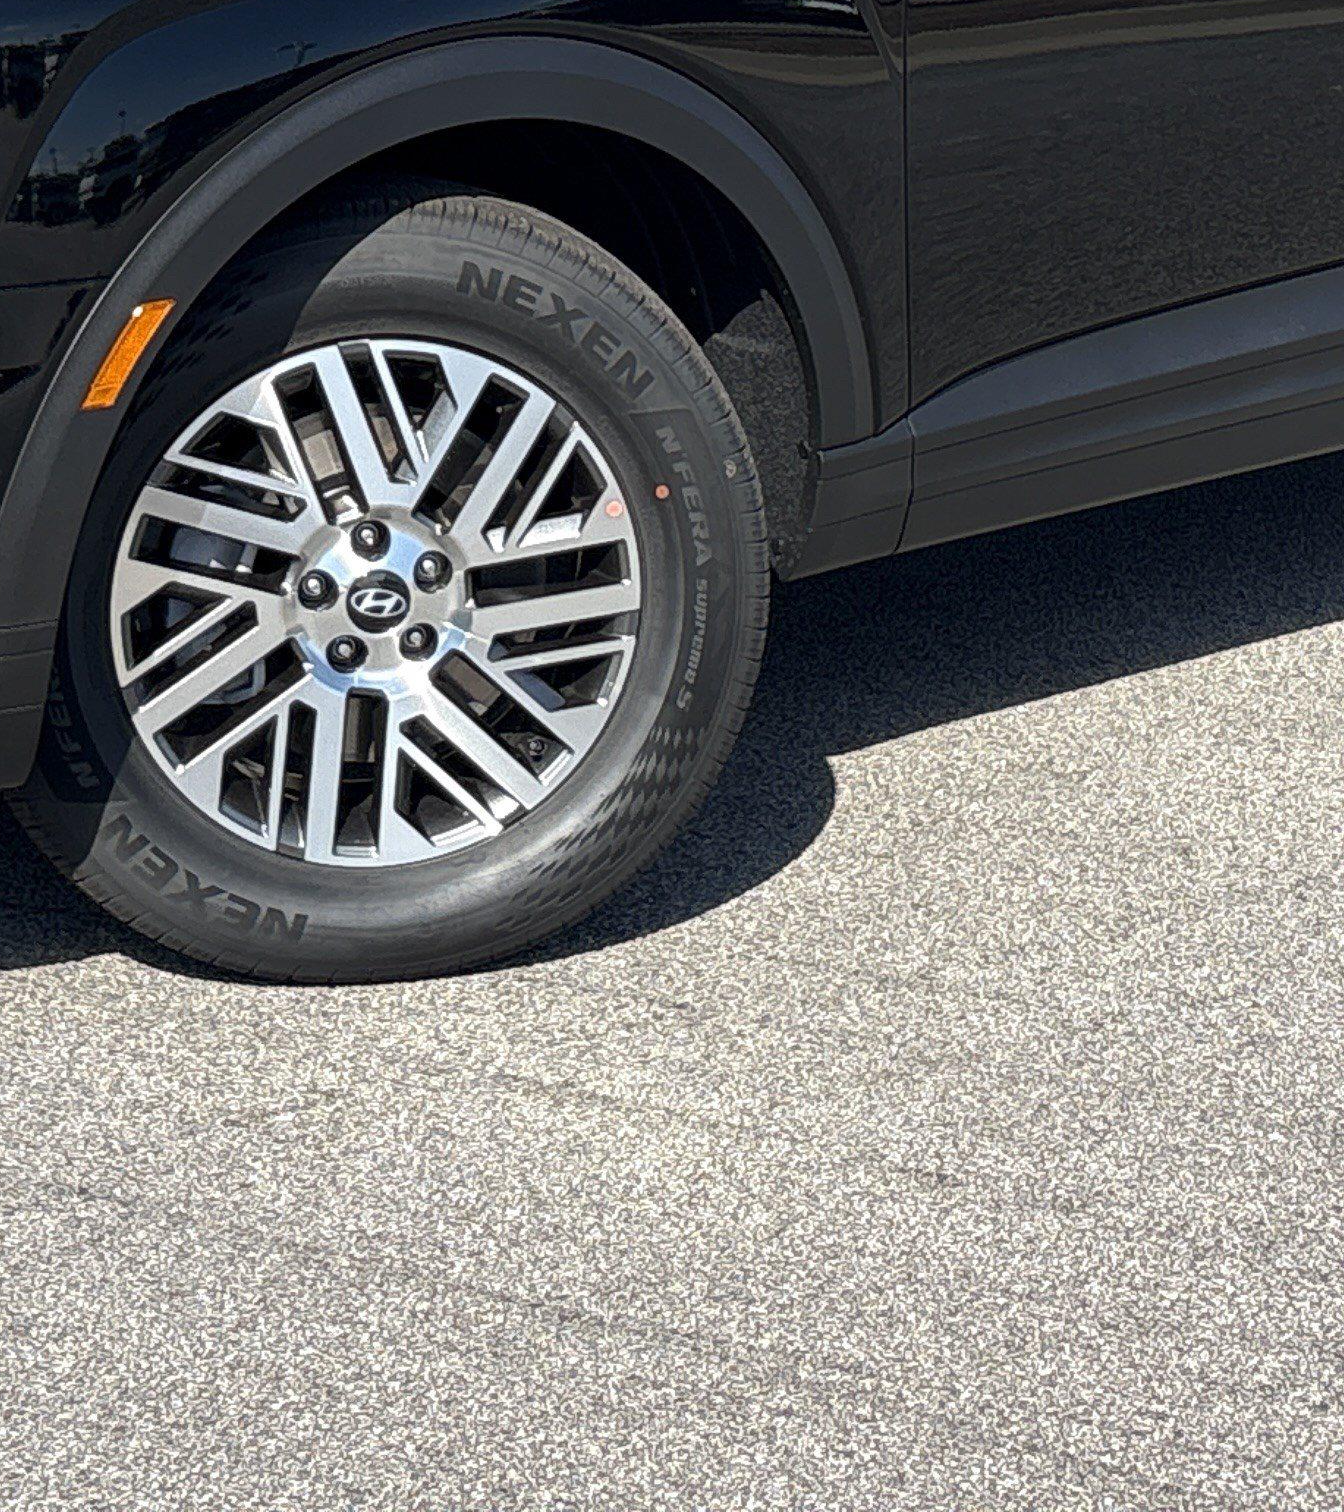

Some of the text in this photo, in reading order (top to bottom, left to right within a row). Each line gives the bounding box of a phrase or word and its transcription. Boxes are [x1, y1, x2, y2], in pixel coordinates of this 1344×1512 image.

[457, 260, 655, 401] NEXEN
[656, 426, 712, 567] N'FERA
[104, 813, 309, 940] NEXEN
